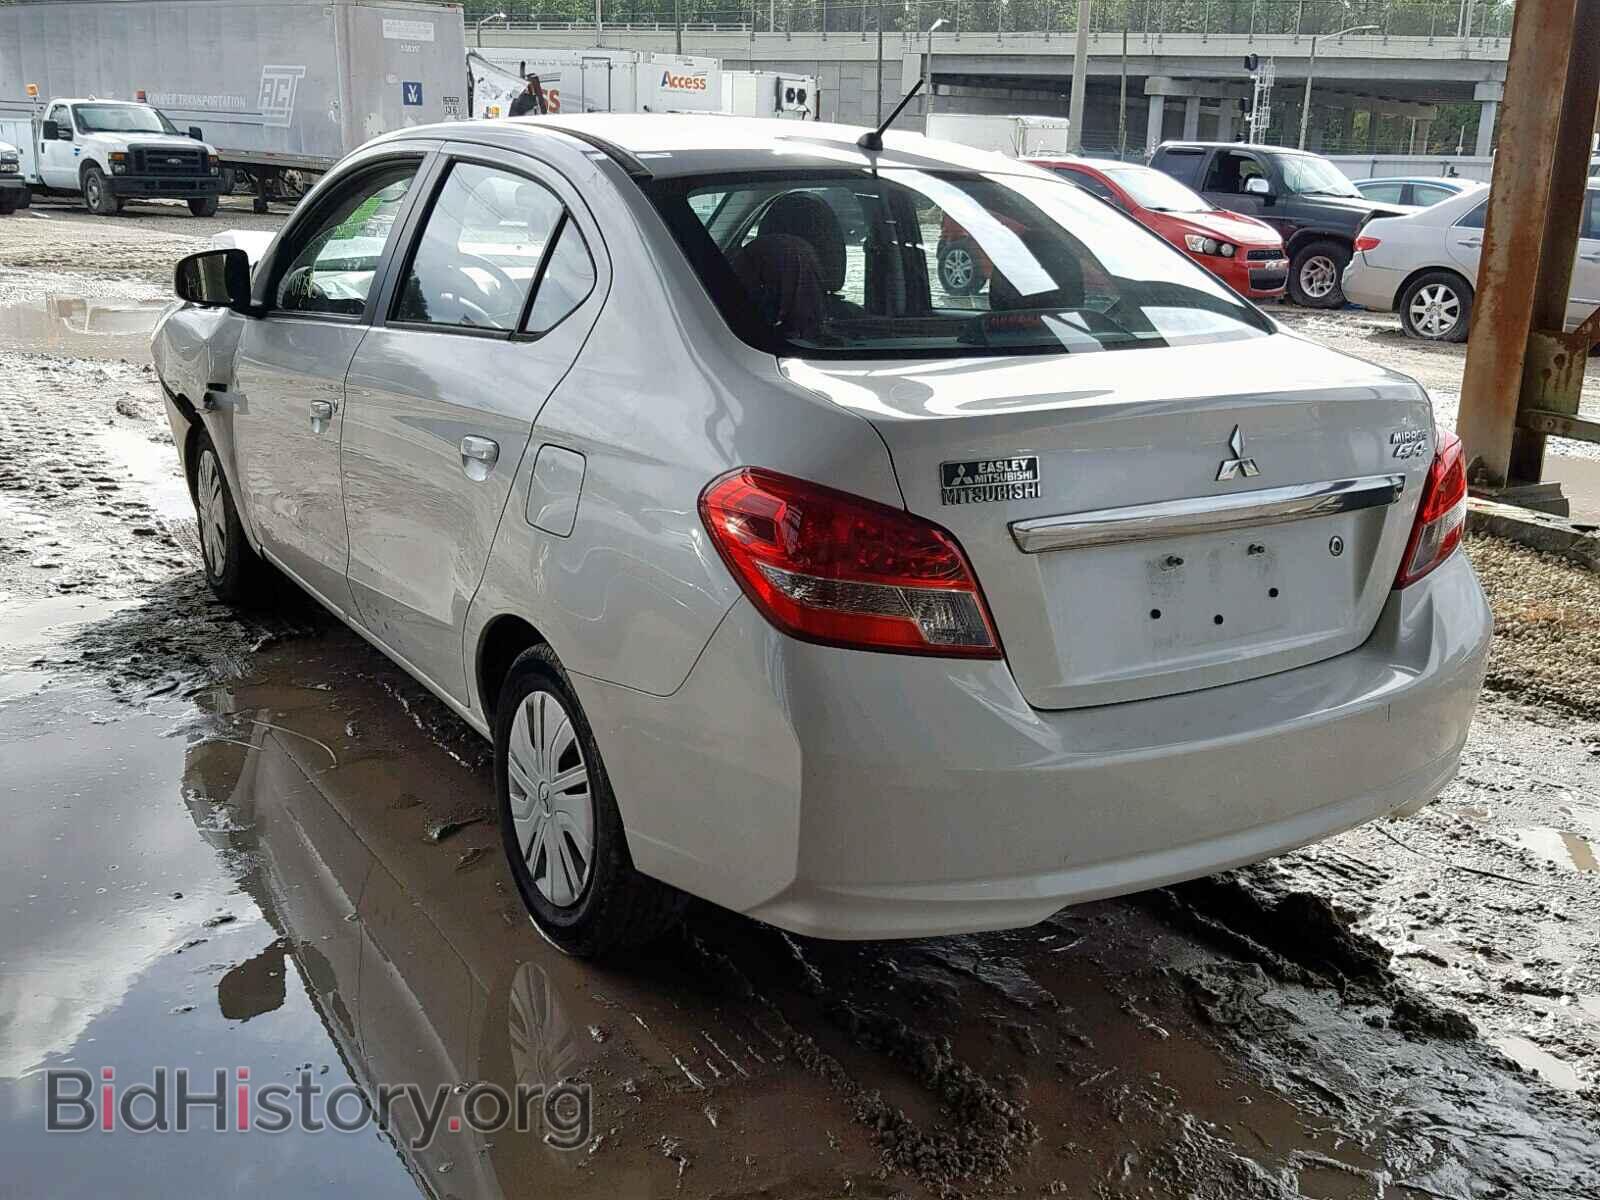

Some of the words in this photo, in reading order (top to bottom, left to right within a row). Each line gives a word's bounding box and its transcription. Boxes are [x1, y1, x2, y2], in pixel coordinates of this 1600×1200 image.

[661, 71, 706, 90] Access
[1390, 430, 1428, 444] MIRAGE
[977, 459, 1028, 474] EASLEY
[974, 470, 1033, 484] MITSUBISHI
[941, 482, 1041, 505] MITSUBISHI
